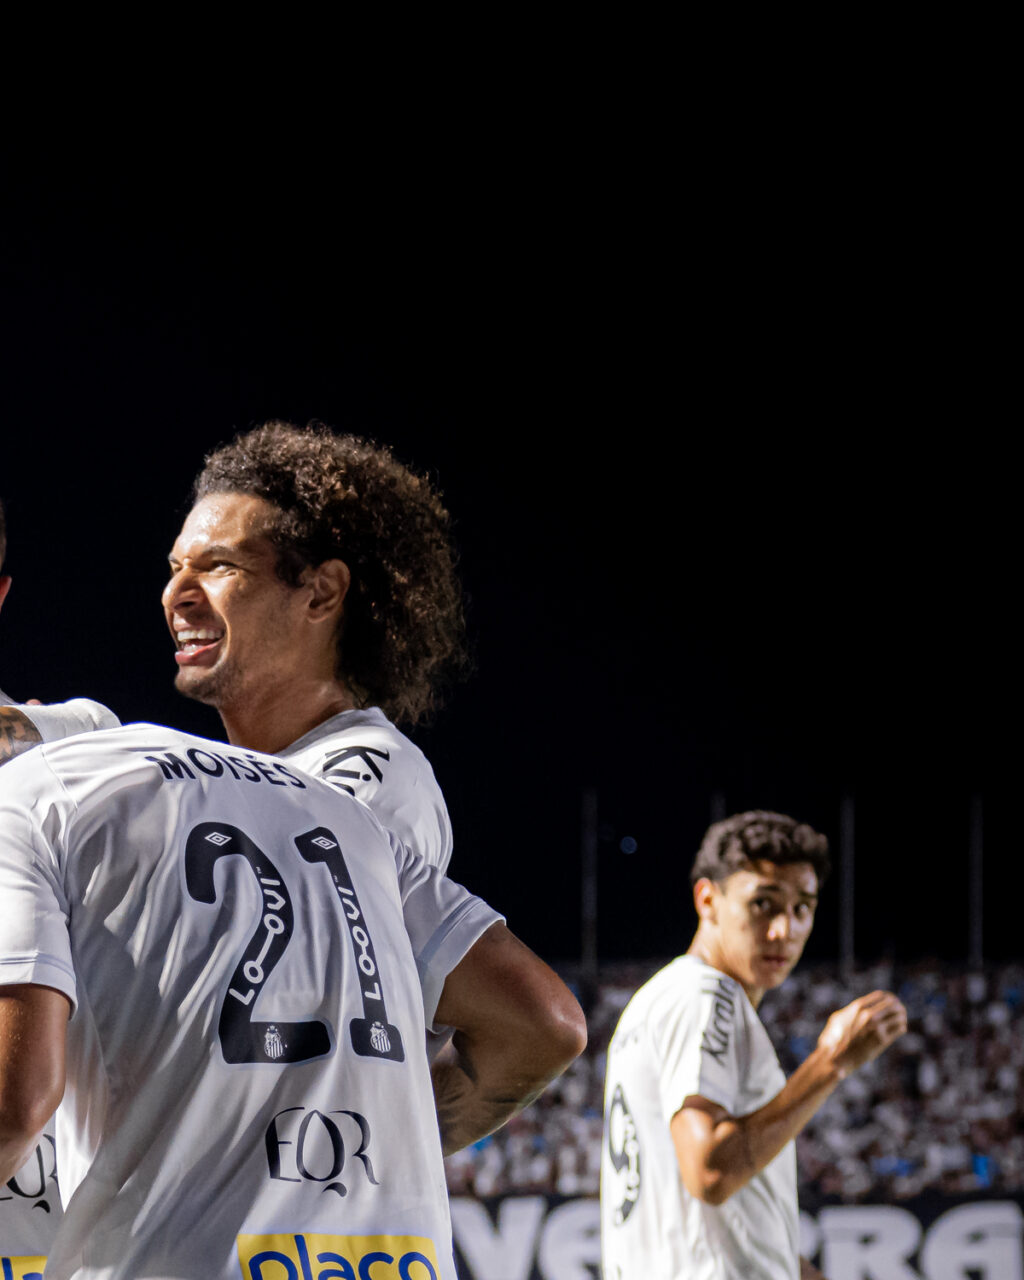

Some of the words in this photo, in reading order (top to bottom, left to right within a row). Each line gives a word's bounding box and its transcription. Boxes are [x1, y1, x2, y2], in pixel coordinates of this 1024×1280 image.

[144, 748, 307, 789] MOISÉS
[184, 821, 406, 1065] 21
[265, 1106, 380, 1198] EQR
